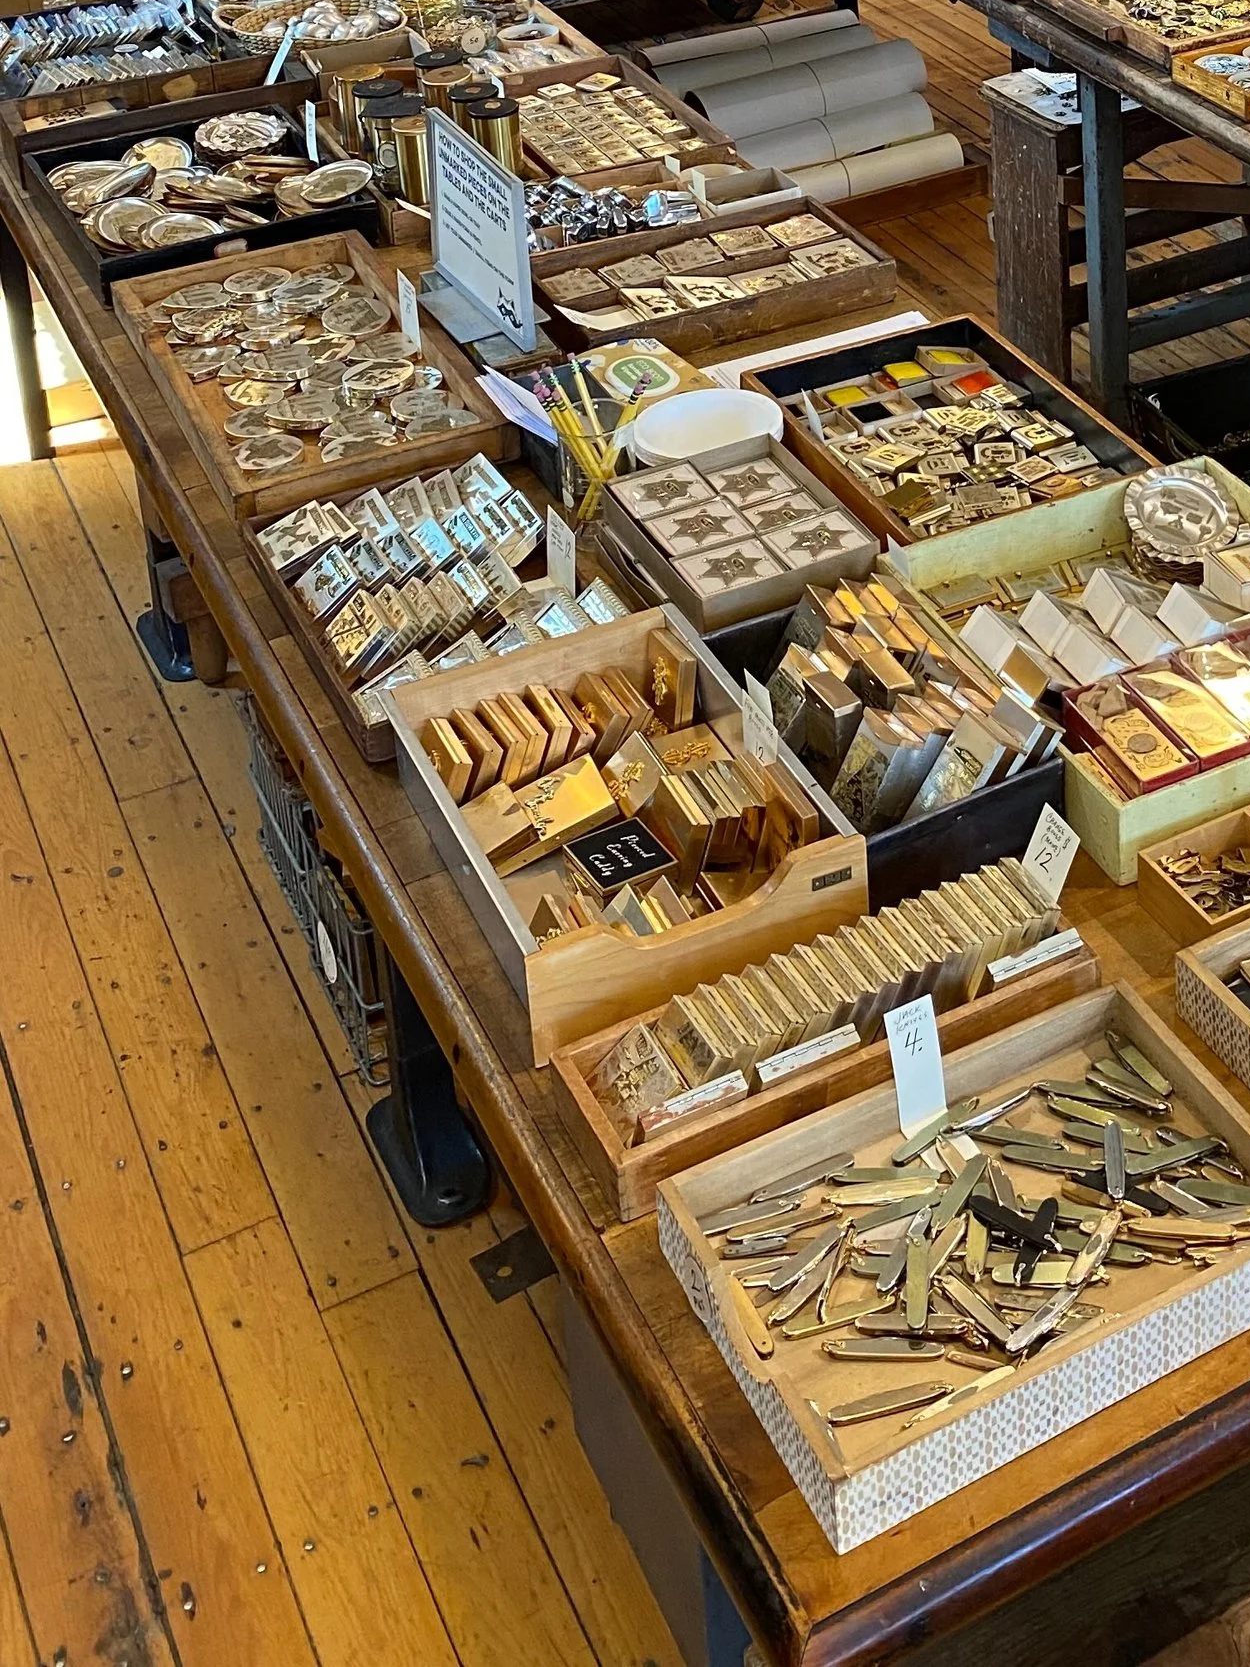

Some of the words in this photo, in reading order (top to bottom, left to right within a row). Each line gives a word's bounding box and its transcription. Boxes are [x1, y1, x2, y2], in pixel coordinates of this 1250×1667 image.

[439, 131, 451, 151] HOW
[452, 143, 460, 158] TO
[460, 150, 475, 171] SHOP
[476, 164, 487, 183] THE
[488, 175, 507, 201] SMALL
[439, 148, 467, 180] UNMARKED
[468, 173, 487, 199] PIECES
[487, 191, 497, 207] ON
[497, 199, 509, 219] THE
[442, 165, 461, 191] TABLES
[462, 184, 473, 202] AND
[474, 194, 485, 213] THE
[486, 206, 506, 231] CARTS
[606, 843, 632, 868] Earring
[620, 834, 656, 858] Pierced
[590, 854, 615, 876] Caddy
[895, 1004, 922, 1024] JACK
[896, 1012, 928, 1036] KNIVES
